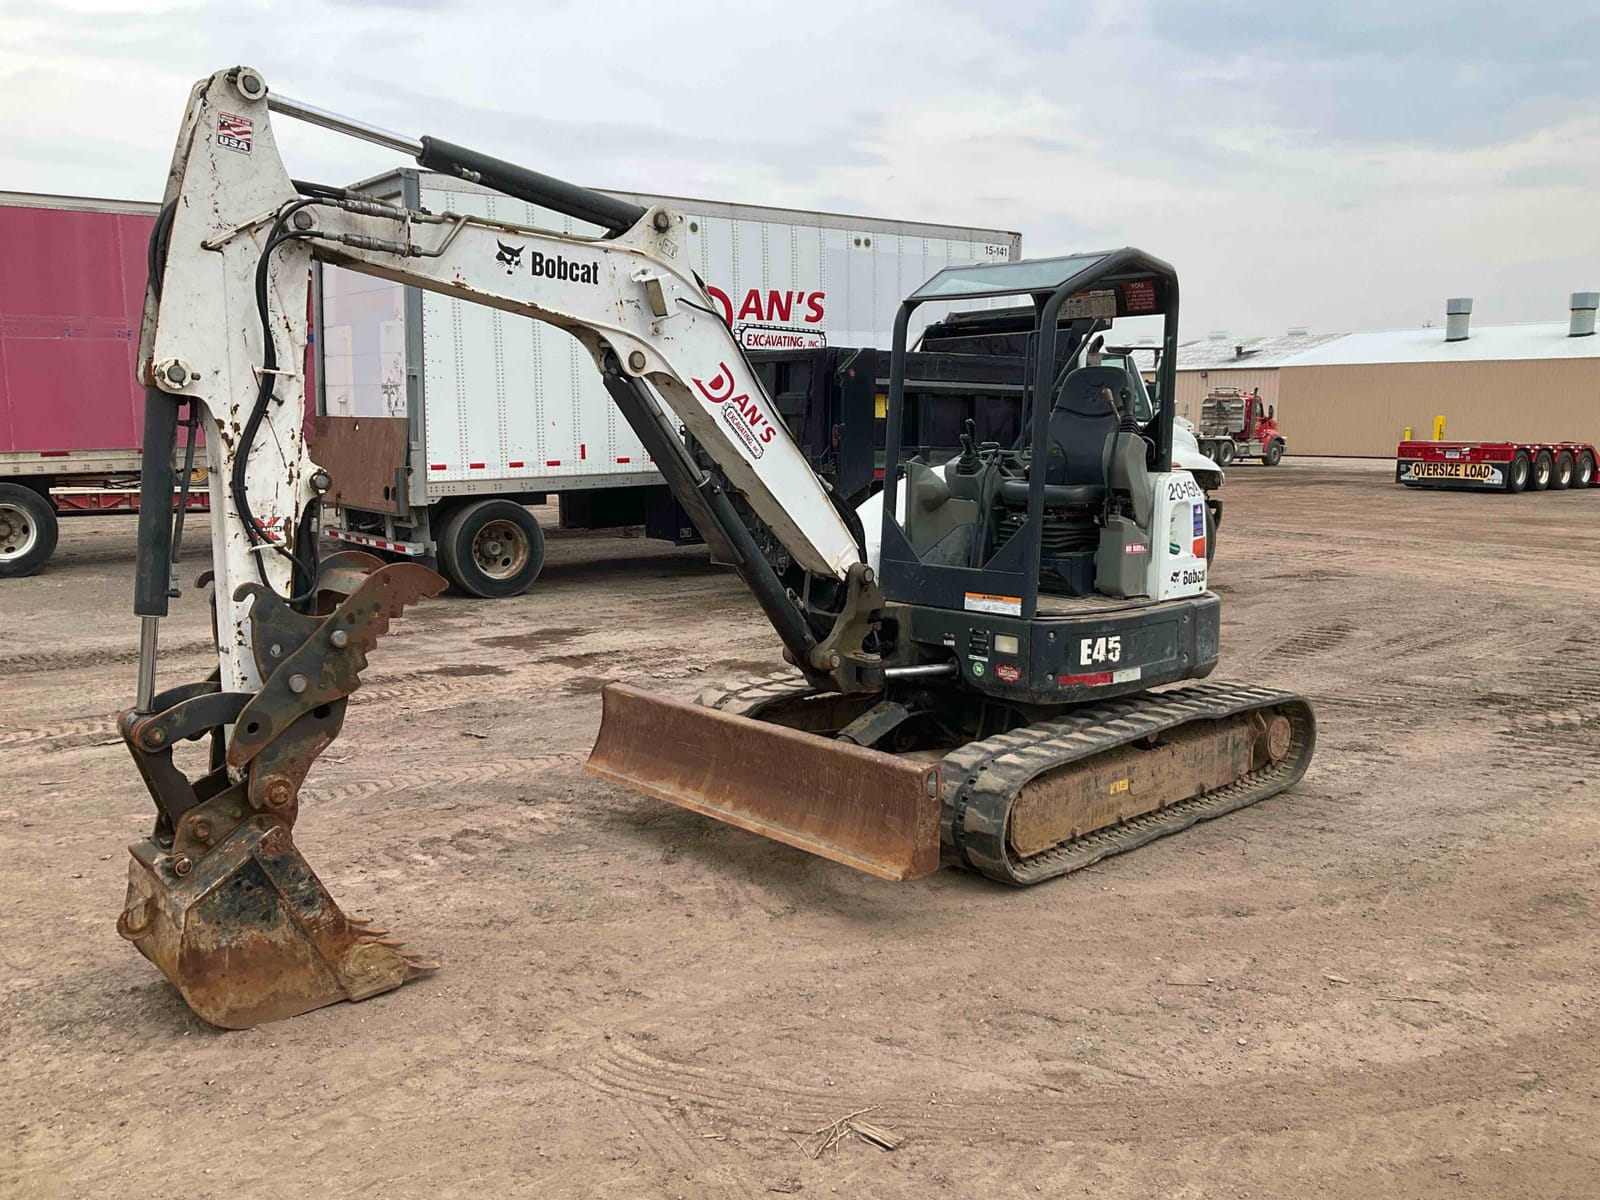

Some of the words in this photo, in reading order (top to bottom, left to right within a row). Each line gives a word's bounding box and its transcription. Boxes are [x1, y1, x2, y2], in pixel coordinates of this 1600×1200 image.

[219, 136, 249, 151] USA
[985, 245, 1008, 257] 15-141
[531, 251, 599, 285] Bobcat
[746, 333, 806, 349] EXCAVATING,
[691, 361, 777, 443] DAN'S
[1413, 463, 1460, 477] OVERSIZE
[1463, 464, 1490, 479] LOAD
[1080, 636, 1121, 665] E45
